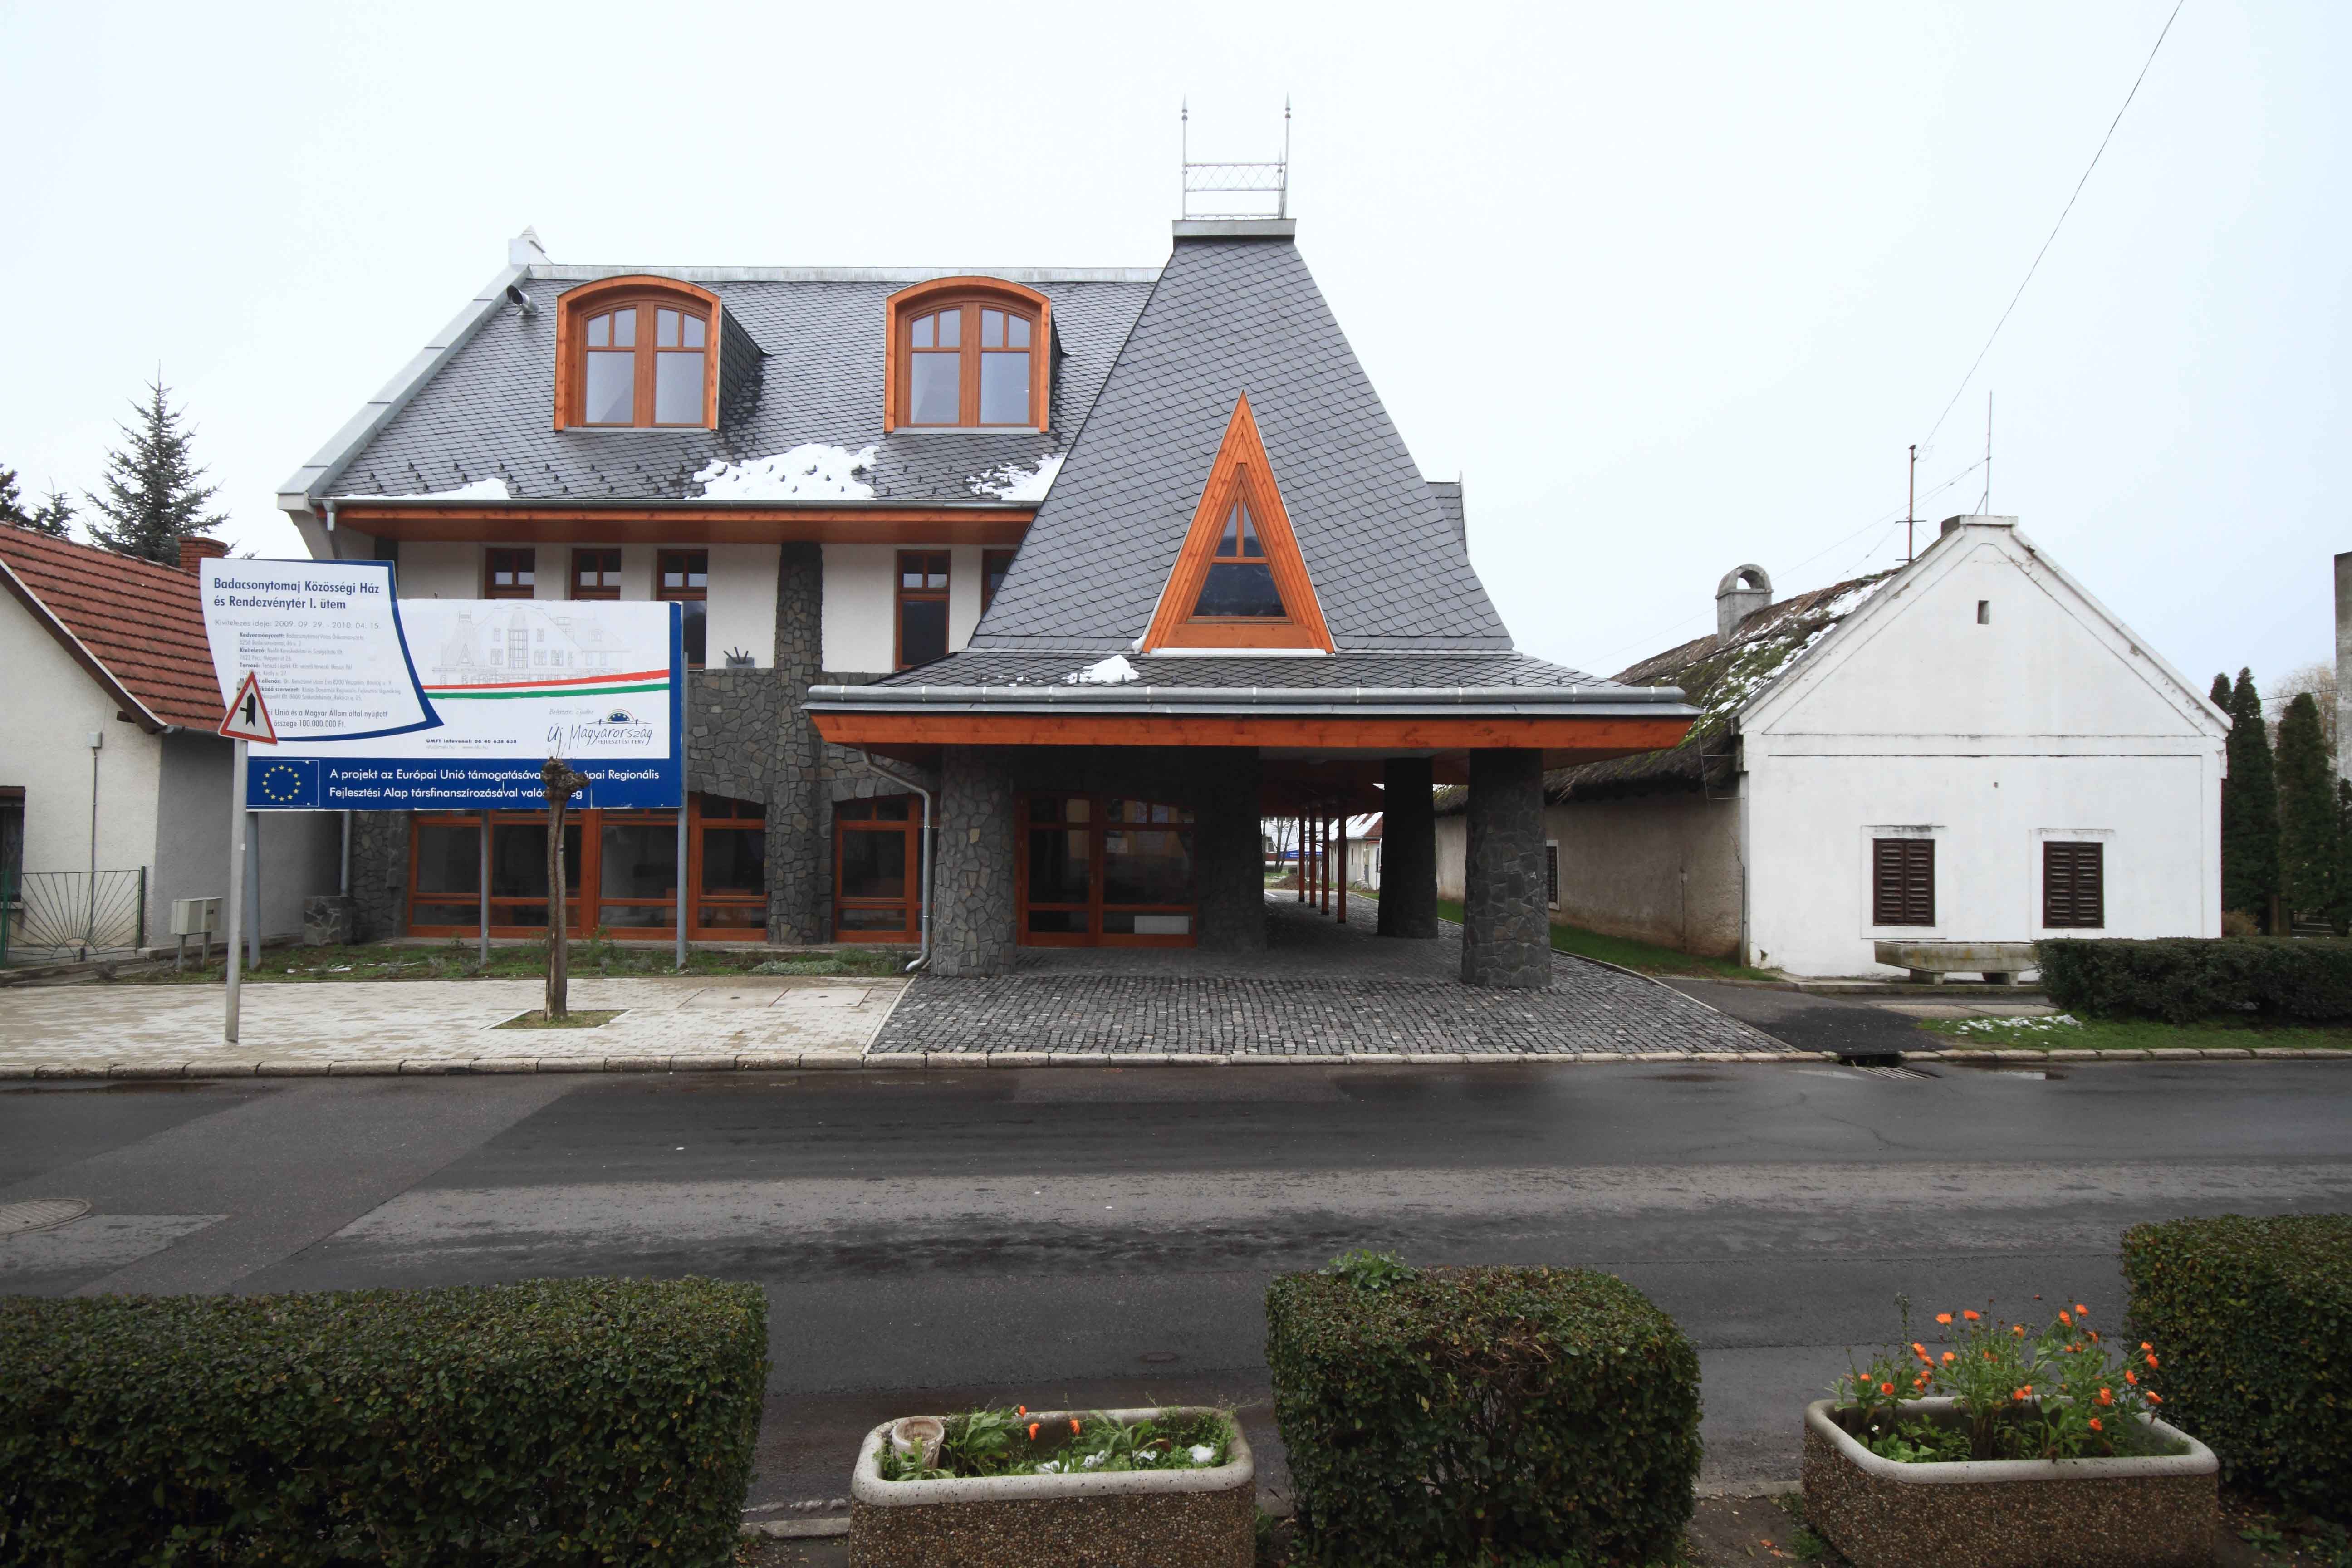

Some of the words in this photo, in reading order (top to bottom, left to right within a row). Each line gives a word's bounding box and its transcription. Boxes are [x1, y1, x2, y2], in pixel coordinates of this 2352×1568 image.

[214, 578, 300, 593] Badacsonytomaj
[305, 580, 356, 595] Közösségi
[360, 583, 380, 594] Ház
[214, 596, 225, 606] és
[230, 596, 306, 610] Rendezvénytér
[310, 598, 316, 608] I.
[320, 598, 346, 609] ütem
[253, 620, 272, 628] ideje:
[304, 709, 327, 718] Magyar
[329, 708, 347, 717] Állam
[364, 710, 387, 719] nyújtott
[274, 720, 297, 728] összege
[547, 723, 563, 751] Új
[568, 724, 652, 750] Magyarország
[330, 769, 338, 779] A
[342, 769, 378, 780] projekt
[397, 769, 436, 781] Európai
[440, 769, 465, 779] Unió
[468, 769, 543, 782] támogatásáva
[609, 769, 659, 782] Regionális
[329, 787, 380, 799] Fejlesztési
[383, 787, 408, 799] Alap
[411, 787, 518, 798] társfinanszírozásával
